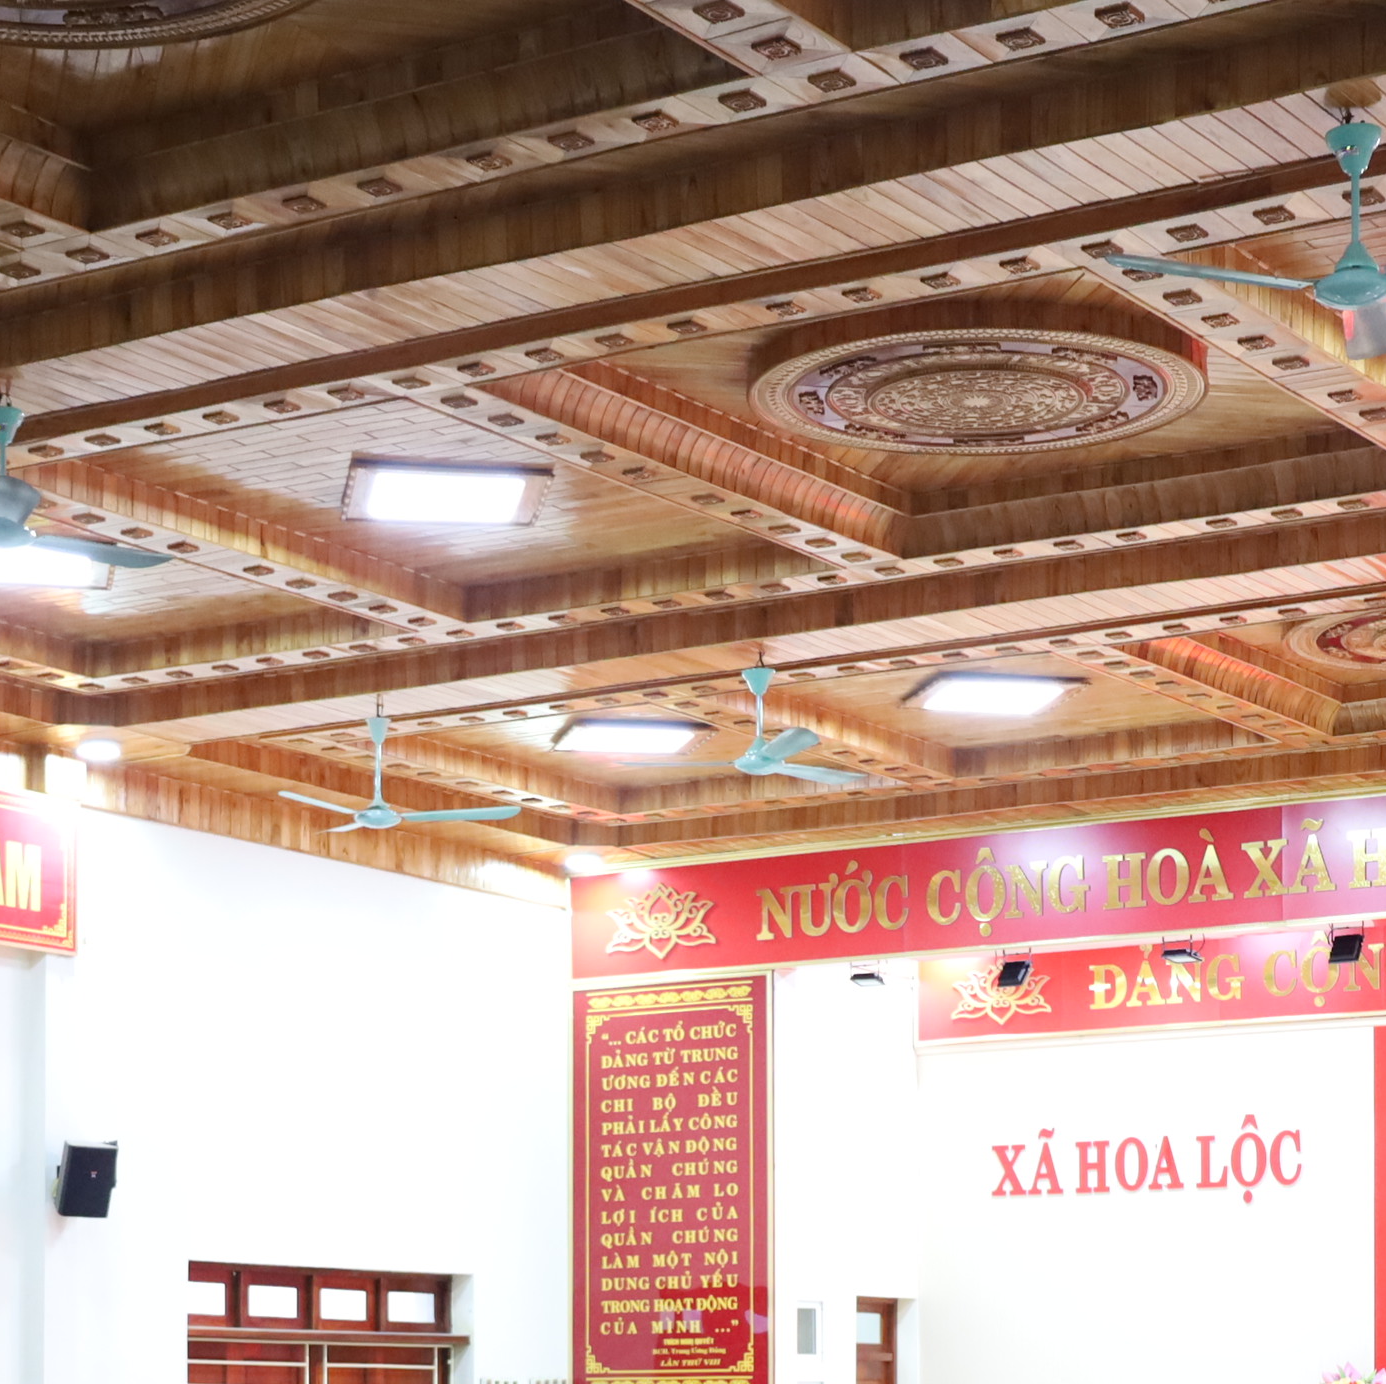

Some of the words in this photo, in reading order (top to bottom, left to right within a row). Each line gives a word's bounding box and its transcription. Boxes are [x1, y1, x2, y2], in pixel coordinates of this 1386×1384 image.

[755, 861, 910, 942] NƯỚC
[925, 847, 1090, 937] CỘNG
[1102, 827, 1234, 911] HOÀ
[1240, 818, 1343, 898] XÃ
[1088, 942, 1246, 1011] ĐẢNG
[625, 1027, 659, 1044] CÁC
[662, 1020, 685, 1042] TỔ
[689, 1021, 737, 1040] CHỨC
[601, 1049, 648, 1069] ĐẢNG
[653, 1047, 676, 1065] TỪ
[680, 1046, 738, 1063] TRUNG
[601, 1074, 651, 1091] ƯƠNG
[700, 1066, 738, 1083] CÁC
[601, 1099, 634, 1113] CHI
[652, 1093, 677, 1113] BỘ
[601, 1115, 645, 1136] PHẢI
[649, 1112, 683, 1133] LẤY
[688, 1113, 738, 1131] CÔNG
[601, 1141, 637, 1158] TÁC
[642, 1138, 680, 1158] VẬN
[685, 1136, 738, 1155] ĐỘNG
[991, 1127, 1065, 1197] XÃ
[1075, 1135, 1185, 1194] HOA
[1195, 1113, 1303, 1204] LỘC
[600, 1158, 652, 1182] QUẦN
[672, 1158, 738, 1176] CHÚNG
[601, 1184, 626, 1202] VÀ
[641, 1183, 701, 1200] CHĂM
[713, 1183, 739, 1197] LO
[601, 1208, 636, 1226] LỢI
[650, 1206, 683, 1223] ÍCH
[696, 1201, 738, 1221] CỦA
[600, 1226, 653, 1249] QUẦN
[672, 1226, 738, 1244] CHÚNG
[601, 1252, 640, 1270] LÀM
[652, 1250, 692, 1269] MỘT
[704, 1248, 738, 1268] NỘI
[601, 1277, 650, 1291] DUNG
[655, 1270, 692, 1289] CHỦ
[700, 1268, 738, 1288] YẾU
[601, 1299, 650, 1313] TRONG
[654, 1298, 693, 1314] HOẠT
[696, 1294, 738, 1313] ĐỘNG
[600, 1317, 638, 1335] CỦA
[651, 1317, 702, 1334] MÌNH
